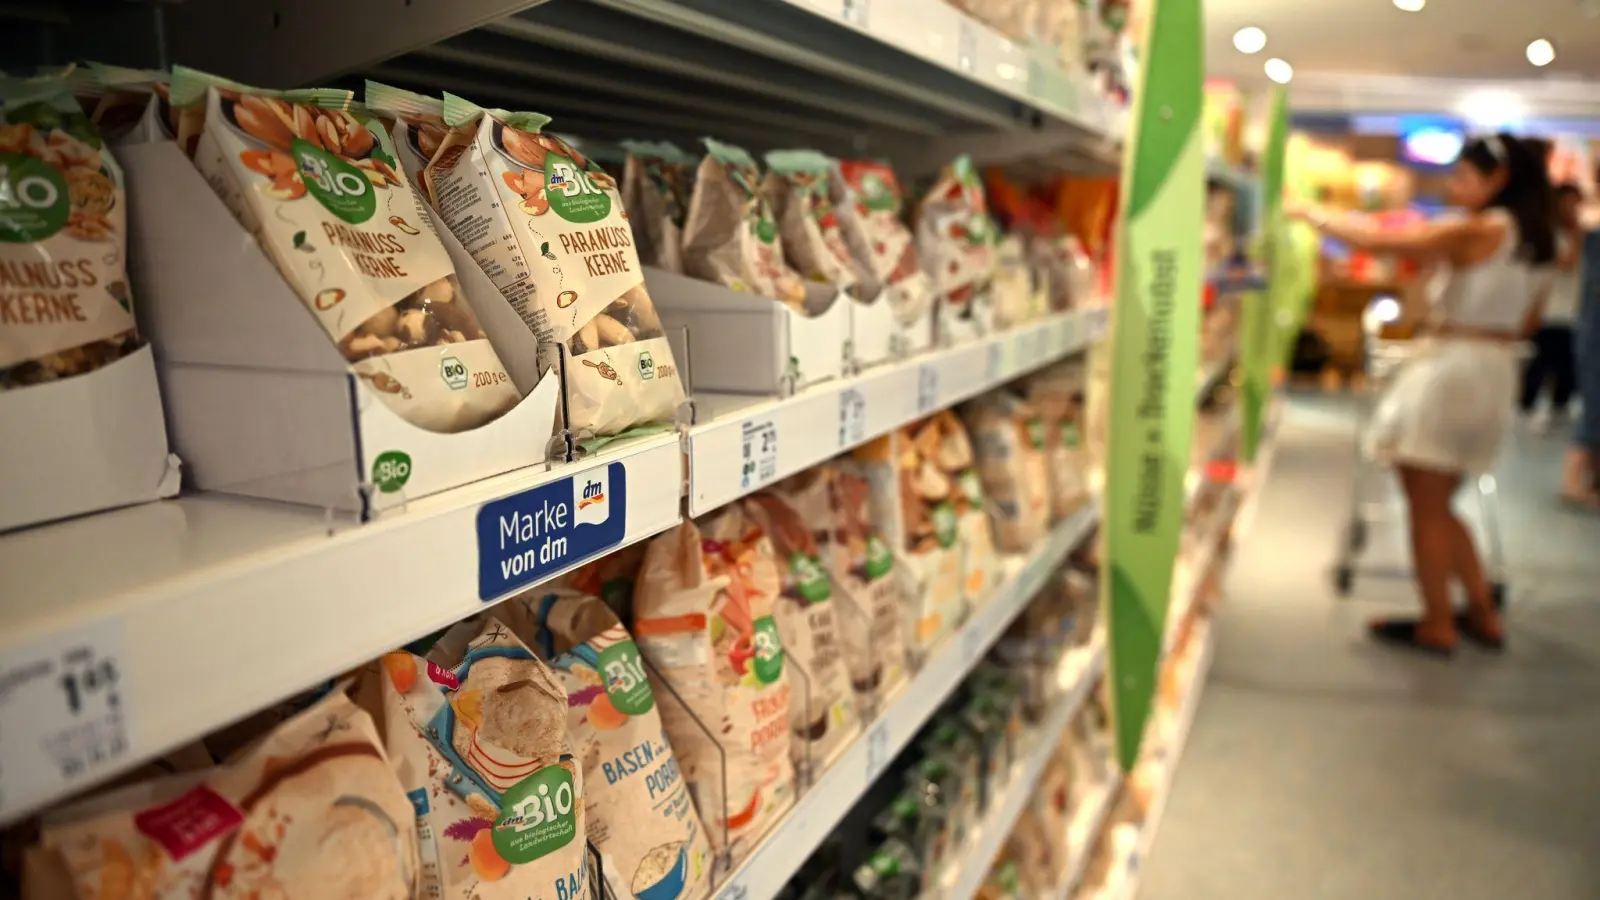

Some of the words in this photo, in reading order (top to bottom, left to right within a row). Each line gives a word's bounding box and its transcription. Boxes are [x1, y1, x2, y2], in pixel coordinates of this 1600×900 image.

[321, 220, 405, 254] PARANUSS
[559, 226, 631, 254] PARANUSS
[0, 259, 98, 289] ALNUSS
[352, 251, 408, 278] KERNE
[584, 250, 630, 277] KERNE
[0, 291, 87, 325] KERNE
[583, 480, 602, 499] dm
[500, 500, 568, 550] Marke
[501, 550, 535, 580] von
[540, 536, 567, 564] dm
[602, 740, 654, 785] BASEN
[510, 835, 524, 847] aus
[524, 820, 569, 839] biologischer
[519, 824, 573, 852] Landwirtschaft
